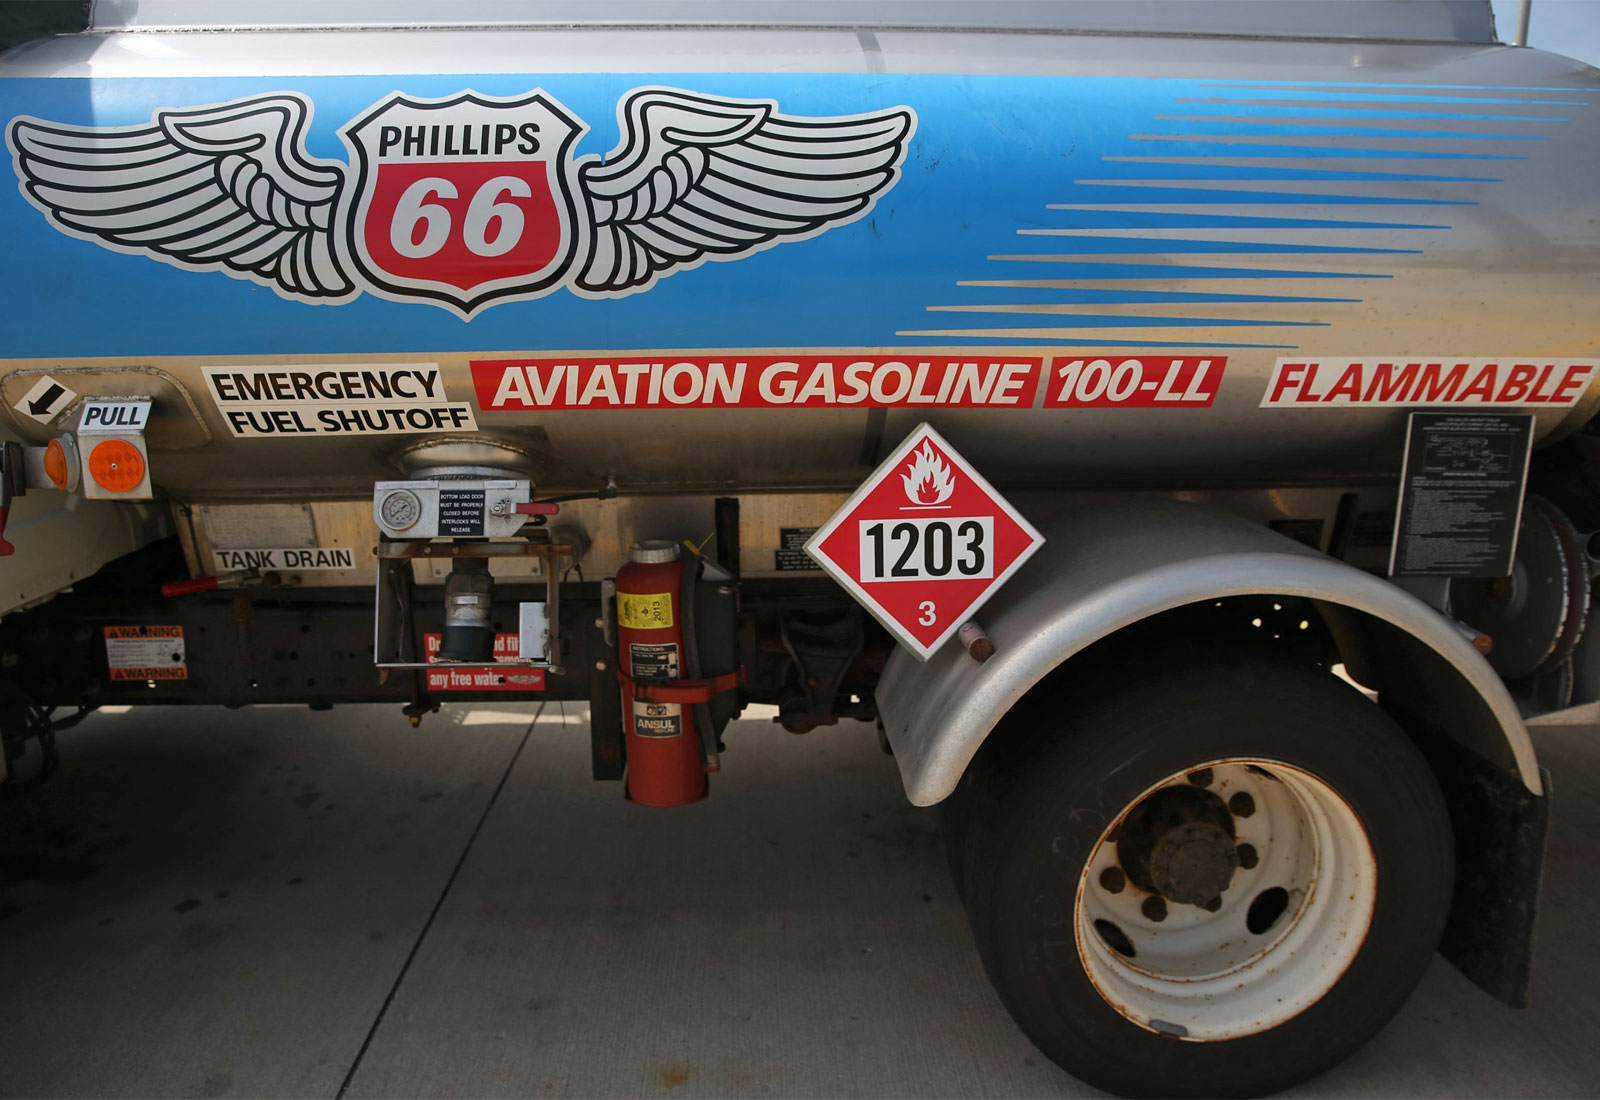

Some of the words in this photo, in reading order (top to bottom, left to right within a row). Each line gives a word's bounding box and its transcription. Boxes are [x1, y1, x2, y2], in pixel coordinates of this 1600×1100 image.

[379, 121, 542, 158] PHILLIPS
[388, 175, 533, 259] 66
[212, 370, 439, 401] EMERGENCY
[492, 362, 747, 407] AVIATION
[757, 359, 1032, 405] GASOLINE
[1057, 358, 1215, 404] 100-LL
[1268, 363, 1594, 404] FLAMMABLE
[84, 406, 142, 426] PULL
[229, 408, 318, 434] FUEL
[318, 407, 469, 432] SHUTOFF
[217, 550, 277, 570] TANK
[284, 548, 353, 568] DRAIN
[865, 520, 986, 578] 1203
[652, 600, 662, 622] 2013
[918, 600, 937, 628] 3
[124, 668, 185, 679] WARNING
[429, 673, 449, 689] any
[450, 671, 471, 686] free
[637, 719, 675, 729] ANSUL
